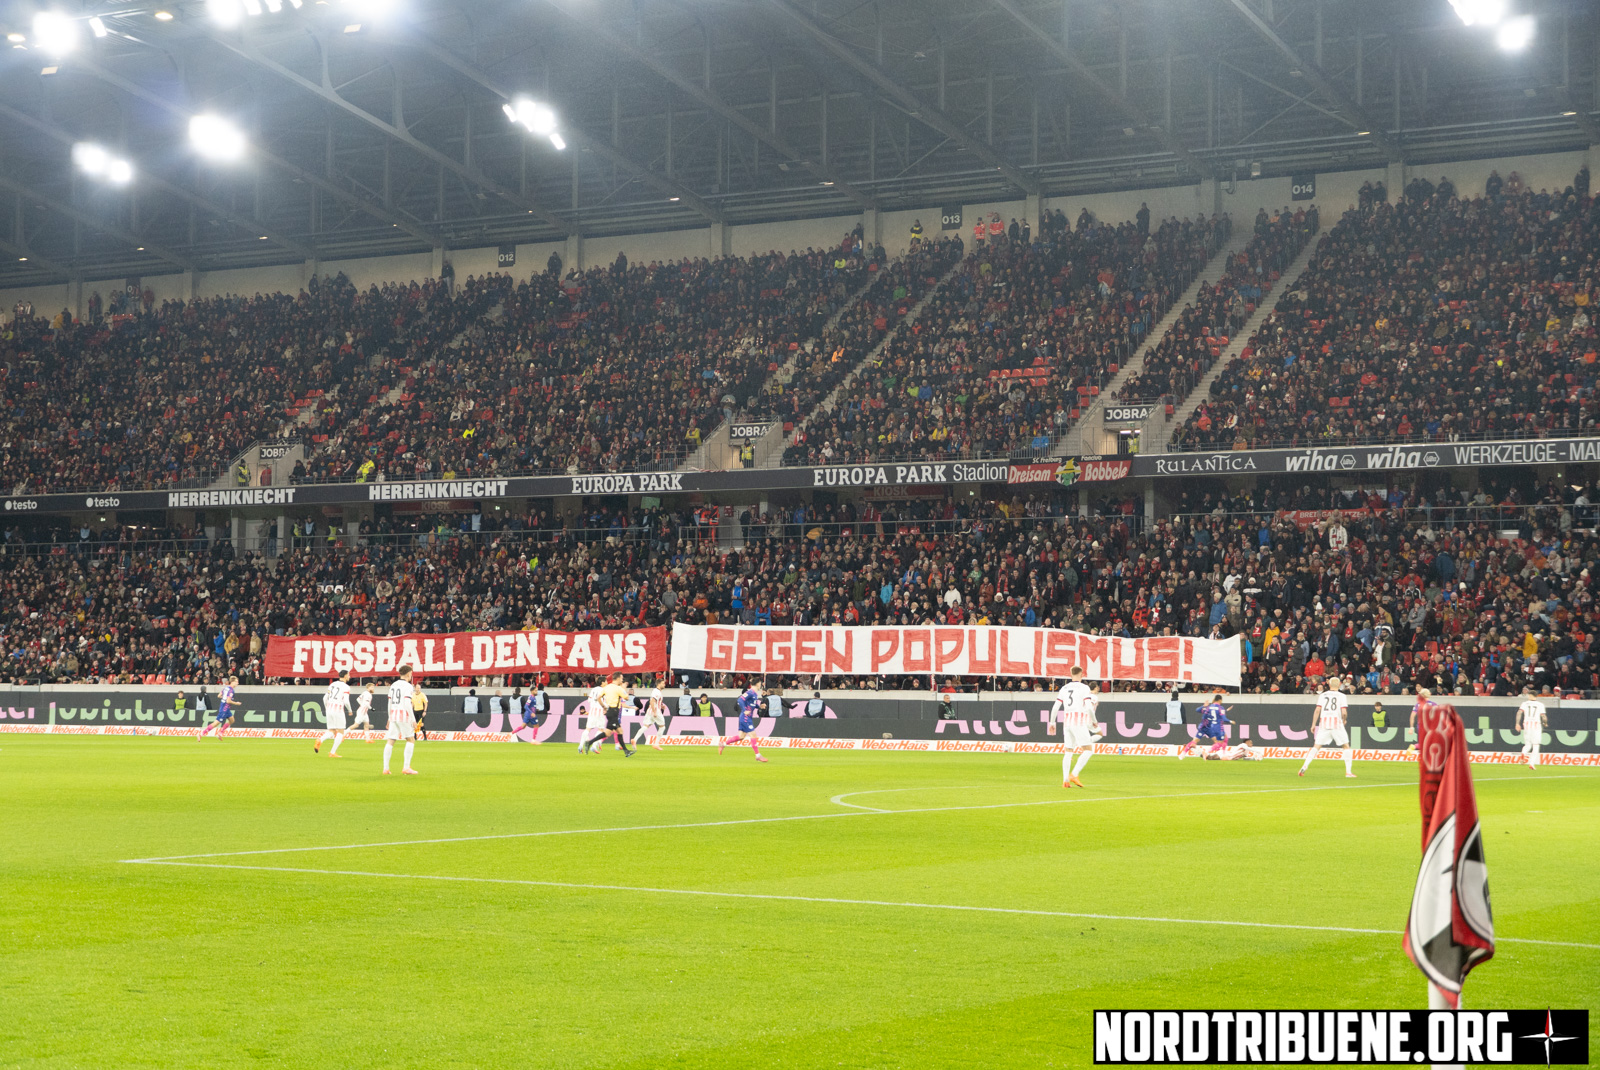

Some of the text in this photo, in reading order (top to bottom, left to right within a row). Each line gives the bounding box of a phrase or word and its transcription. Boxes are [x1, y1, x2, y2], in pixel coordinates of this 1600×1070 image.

[1292, 184, 1313, 195] 014
[942, 214, 960, 224] 013
[498, 253, 514, 262] 012
[1106, 407, 1155, 420] JOBRA
[1285, 450, 1338, 472] wiha
[1367, 447, 1421, 469] wiha
[1454, 443, 1556, 464] WERKZEUGE
[813, 460, 1007, 486] EUROPA PARK Stadion
[1008, 461, 1128, 484] Dreisam Bobbele
[369, 480, 508, 500] HERRENKNECHT
[571, 473, 682, 494] EUROPA PARK
[873, 486, 908, 496] KIOSK
[12, 499, 38, 510] testo
[94, 496, 120, 507] testo
[168, 488, 295, 507] HERRENKNECHT
[421, 501, 450, 510] KIOSK
[293, 632, 647, 674] FUSSBALL DEN FANS
[704, 627, 1194, 680] GEGEN POPULISMUS!
[391, 688, 402, 704] 29
[1067, 690, 1074, 707] 3
[1324, 696, 1337, 711] 28
[1527, 705, 1537, 718] 17
[0, 724, 47, 733] WeberHaus
[51, 725, 99, 735] WeberHaus
[104, 725, 150, 735] WeberHau
[788, 738, 855, 749] WeberHaus
[861, 740, 929, 750] WeberHaus
[1094, 744, 1168, 755] WeberHaus
[1263, 747, 1343, 759] Weberaus
[1468, 752, 1529, 764] berHaus
[1540, 754, 1600, 765] WeberH
